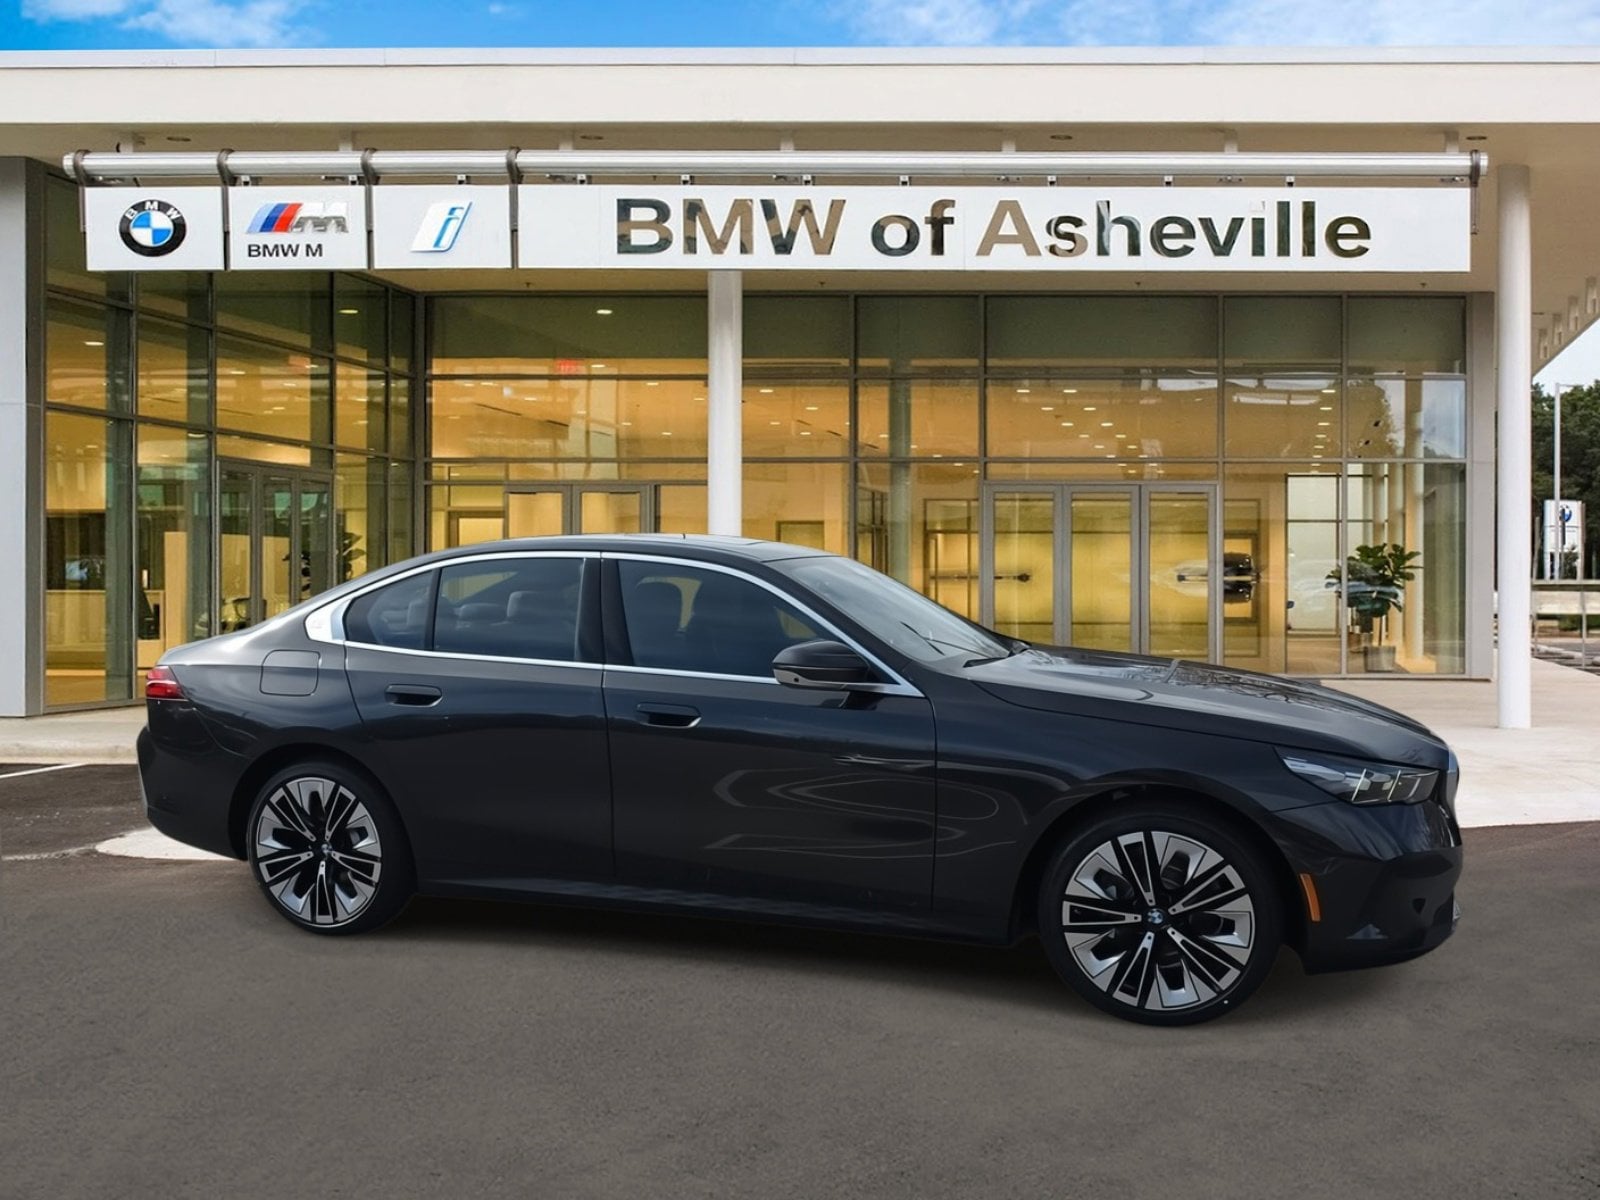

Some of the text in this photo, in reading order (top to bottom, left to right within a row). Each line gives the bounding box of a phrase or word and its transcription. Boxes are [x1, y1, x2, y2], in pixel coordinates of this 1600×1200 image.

[125, 199, 181, 220] BMW
[616, 198, 1372, 258] BMW of Asheville
[247, 243, 323, 257] BMW M
